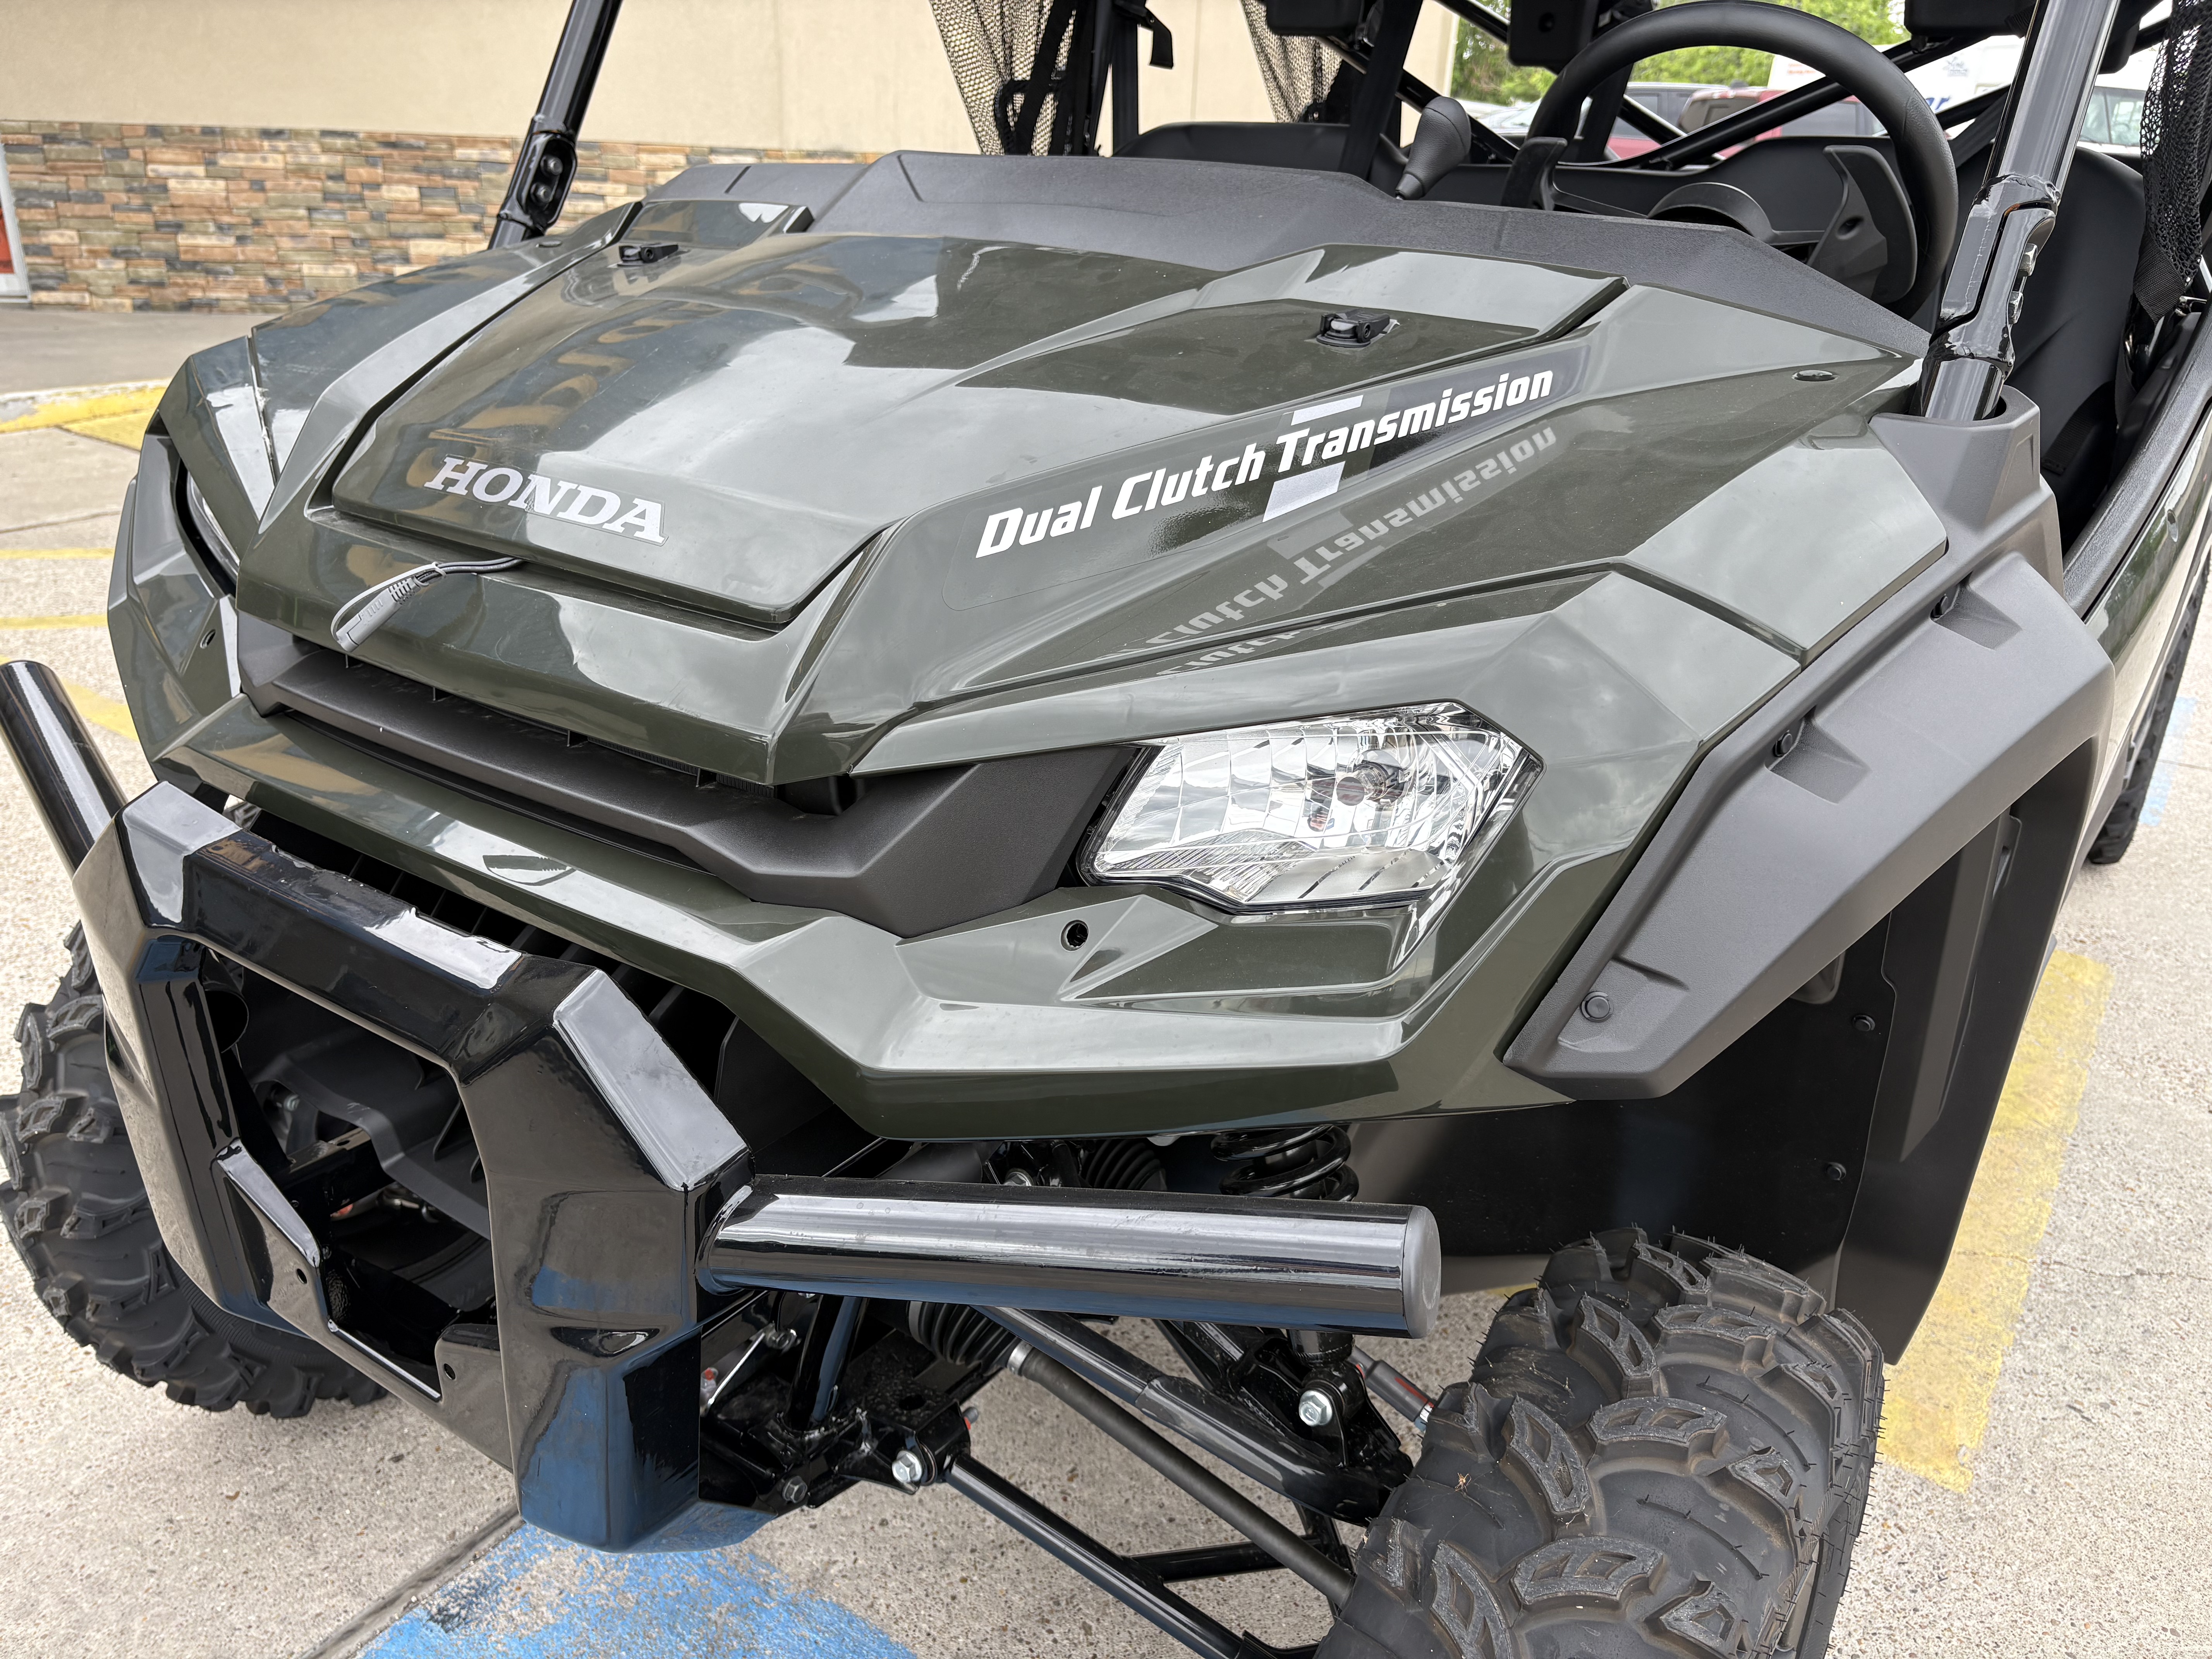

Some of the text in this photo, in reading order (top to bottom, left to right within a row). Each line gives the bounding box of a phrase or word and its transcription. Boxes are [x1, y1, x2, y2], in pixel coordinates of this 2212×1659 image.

[424, 457, 665, 544] HONDA
[975, 370, 1553, 558] Dual Clutch Transmission
